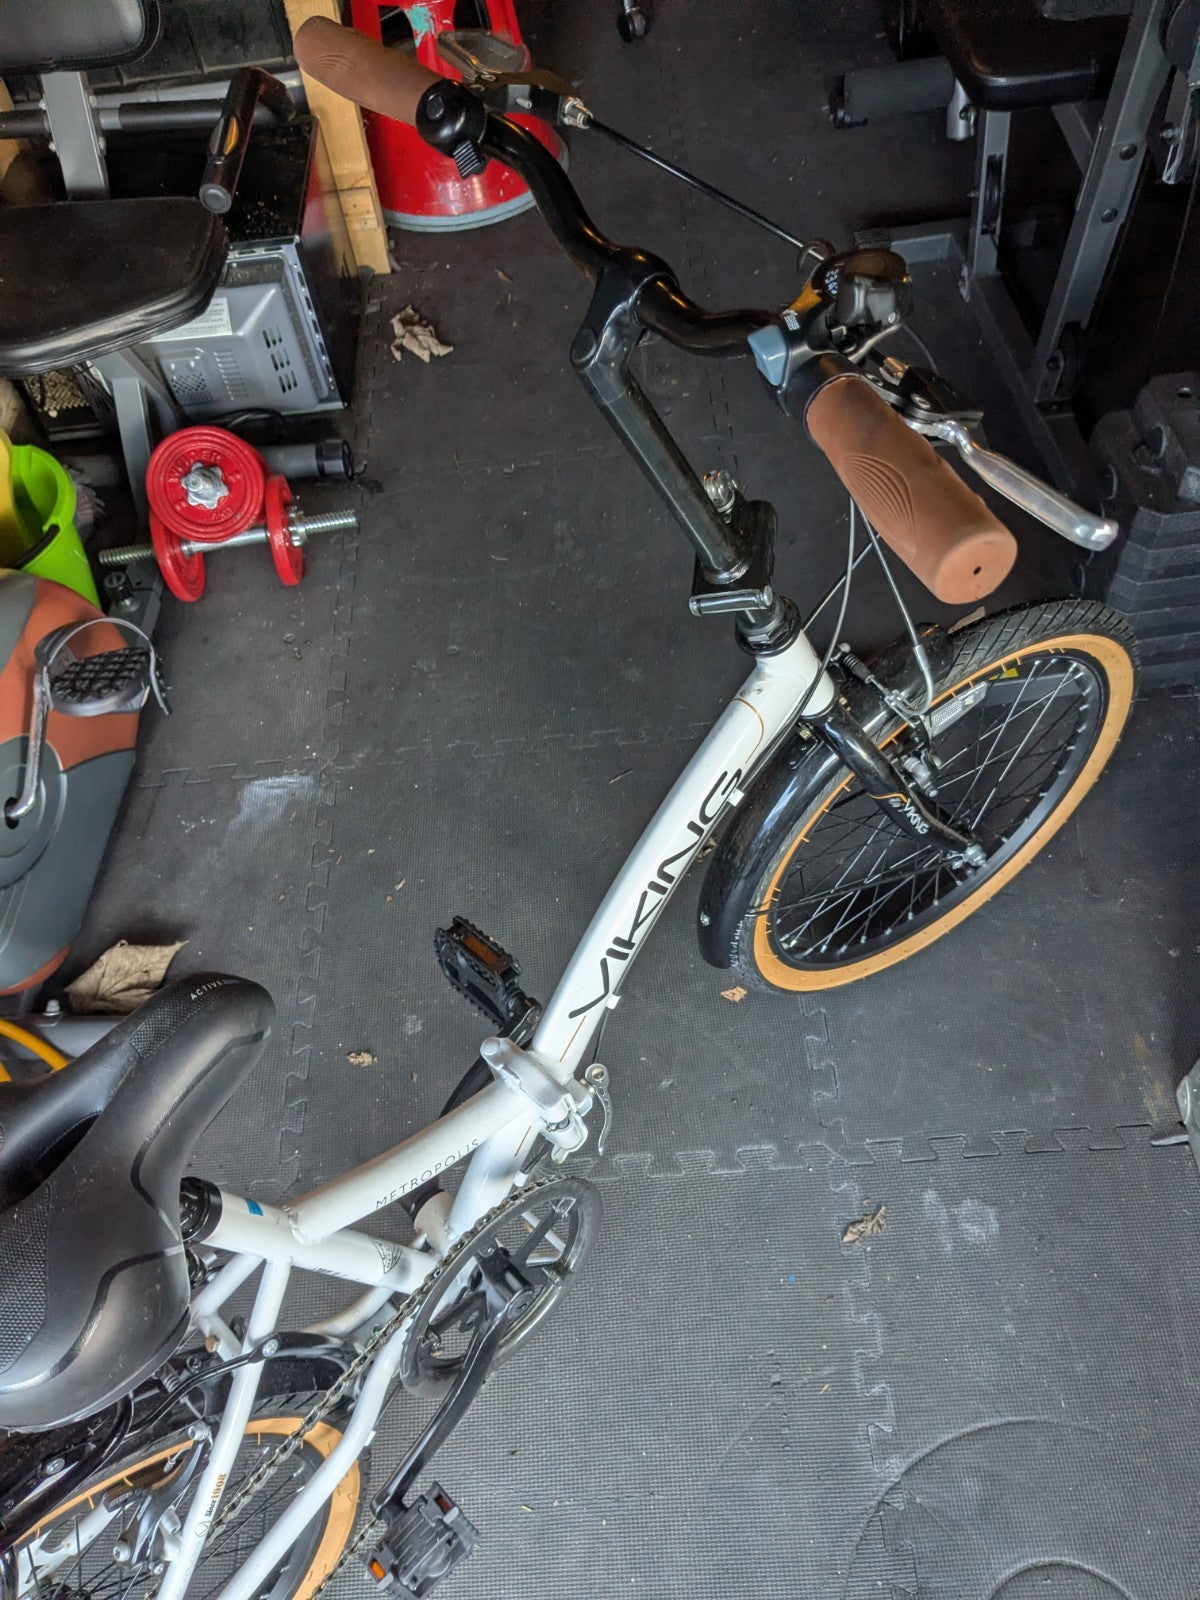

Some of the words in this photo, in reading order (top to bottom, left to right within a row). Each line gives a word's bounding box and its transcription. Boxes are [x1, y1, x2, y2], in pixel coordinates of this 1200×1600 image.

[903, 798, 930, 834] VIKING
[568, 768, 742, 1019] VIKING
[375, 1138, 479, 1210] METROPOLIS
